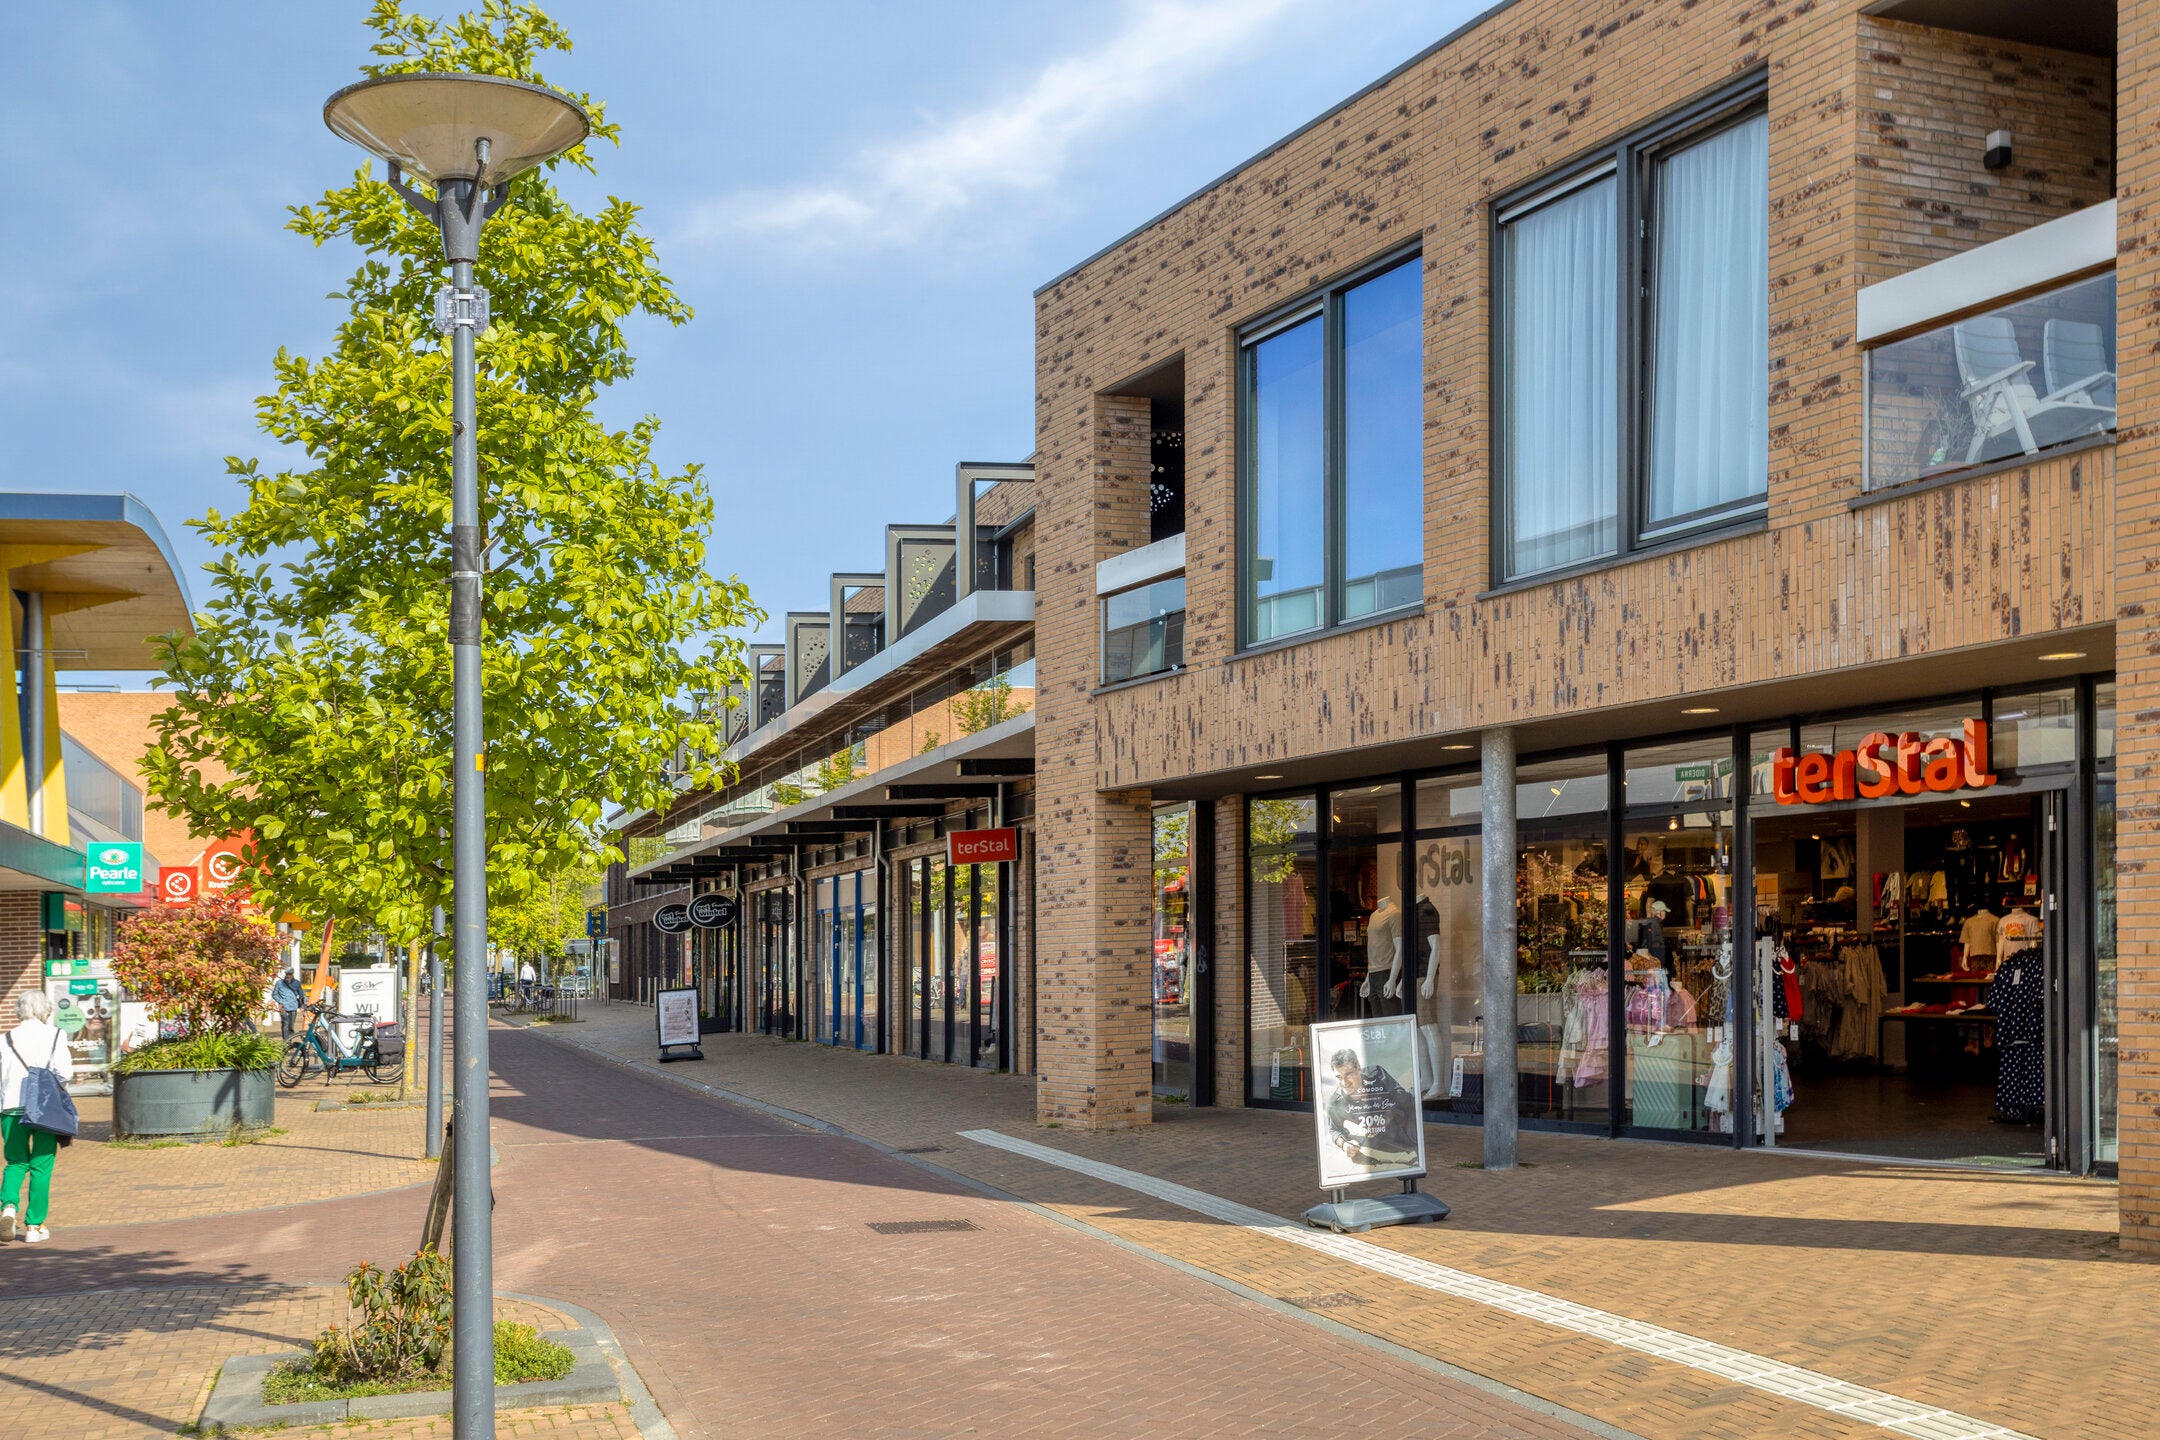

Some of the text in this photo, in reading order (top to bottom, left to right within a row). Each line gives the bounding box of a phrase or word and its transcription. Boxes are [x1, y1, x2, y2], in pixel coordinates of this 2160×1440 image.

[1773, 718, 1997, 805] terStal
[957, 837, 1010, 855] terStal
[1396, 838, 1474, 891] rStal
[89, 866, 138, 880] Pearle
[699, 908, 727, 917] winkel
[355, 1003, 380, 1013] WIJ
[66, 1038, 105, 1049] ogcheck
[1357, 1086, 1384, 1094] COMODO
[1358, 1115, 1386, 1127] 20%
[1362, 1126, 1386, 1135] ORTING
